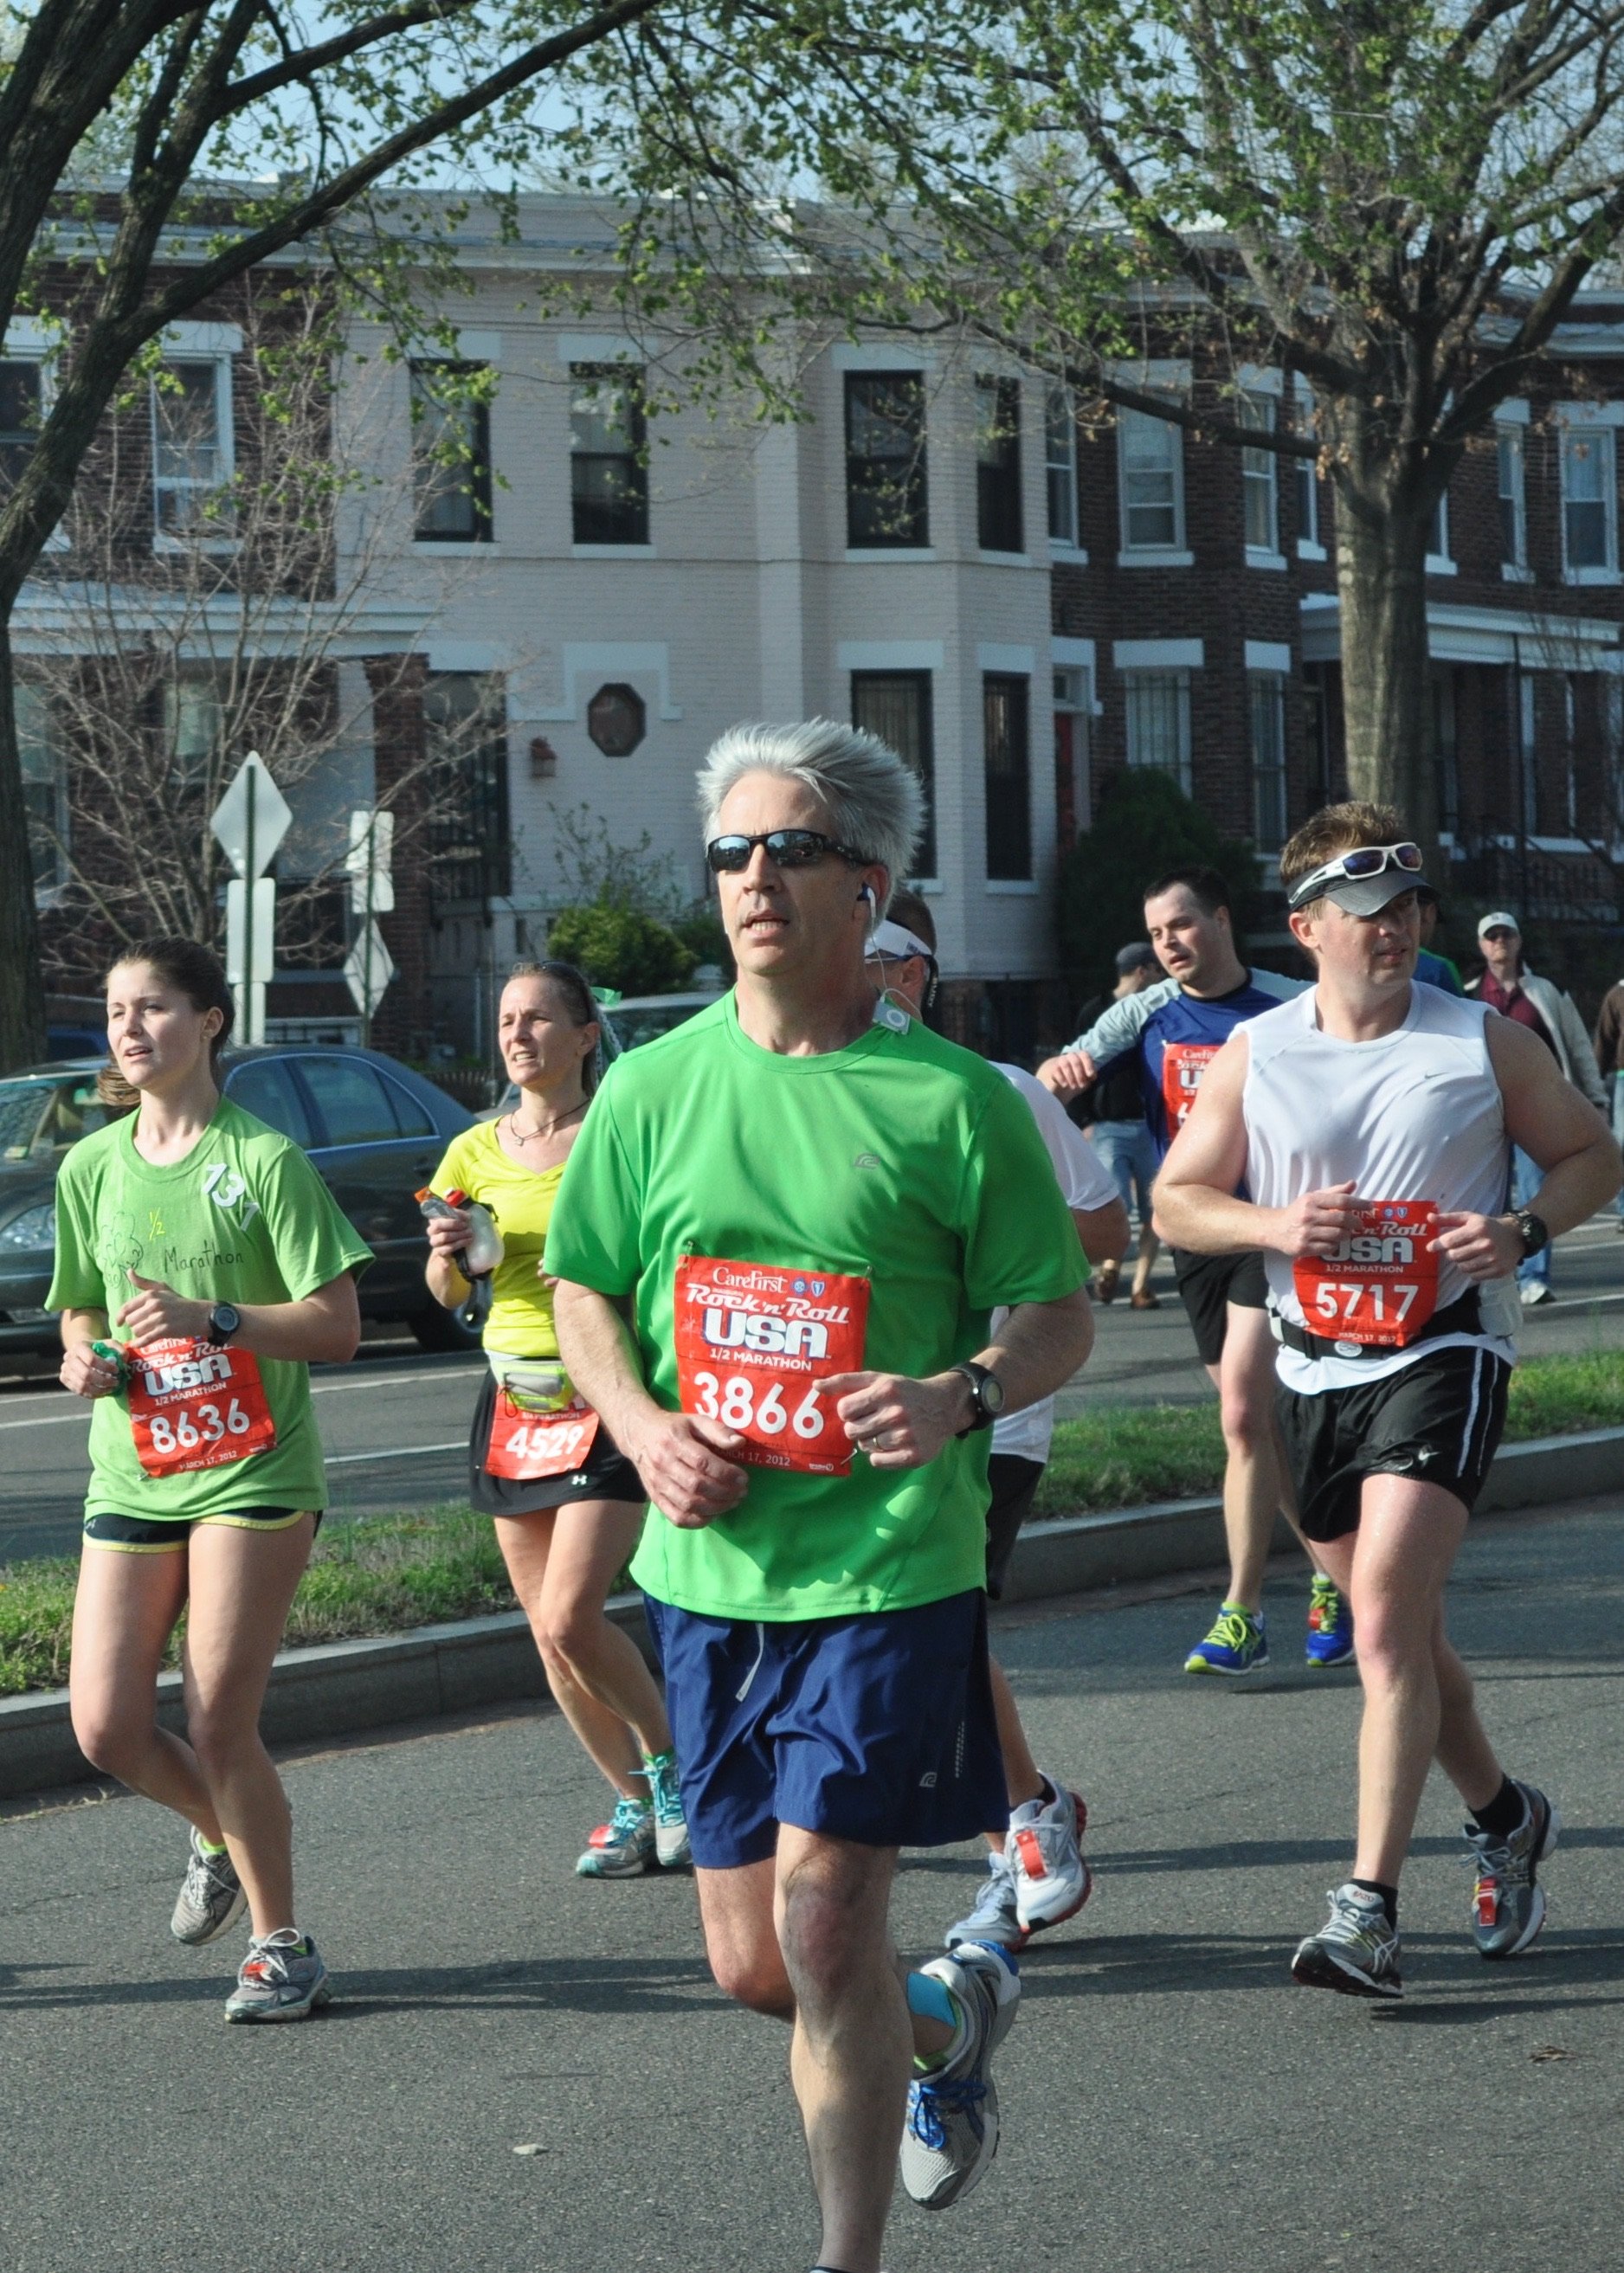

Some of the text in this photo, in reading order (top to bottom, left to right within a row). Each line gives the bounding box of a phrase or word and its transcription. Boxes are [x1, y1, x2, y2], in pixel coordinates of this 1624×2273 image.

[1379, 1221, 1427, 1236] Roll
[164, 1240, 244, 1273] Marathon
[1326, 1265, 1341, 1273] 1/2
[712, 1266, 788, 1293] CareFirst
[1316, 1283, 1419, 1322] 5717
[705, 1308, 828, 1358] USA
[145, 1353, 233, 1396] USA
[710, 1348, 812, 1371] 1/2 MARATHON
[155, 1382, 227, 1407] 1/2 MARATHON
[694, 1372, 824, 1439] 3866
[150, 1398, 249, 1454] 8636
[506, 1425, 584, 1459] 4529
[179, 1460, 204, 1470] MARCH
[219, 1450, 237, 1461] 2012
[765, 1454, 790, 1466] 2012
